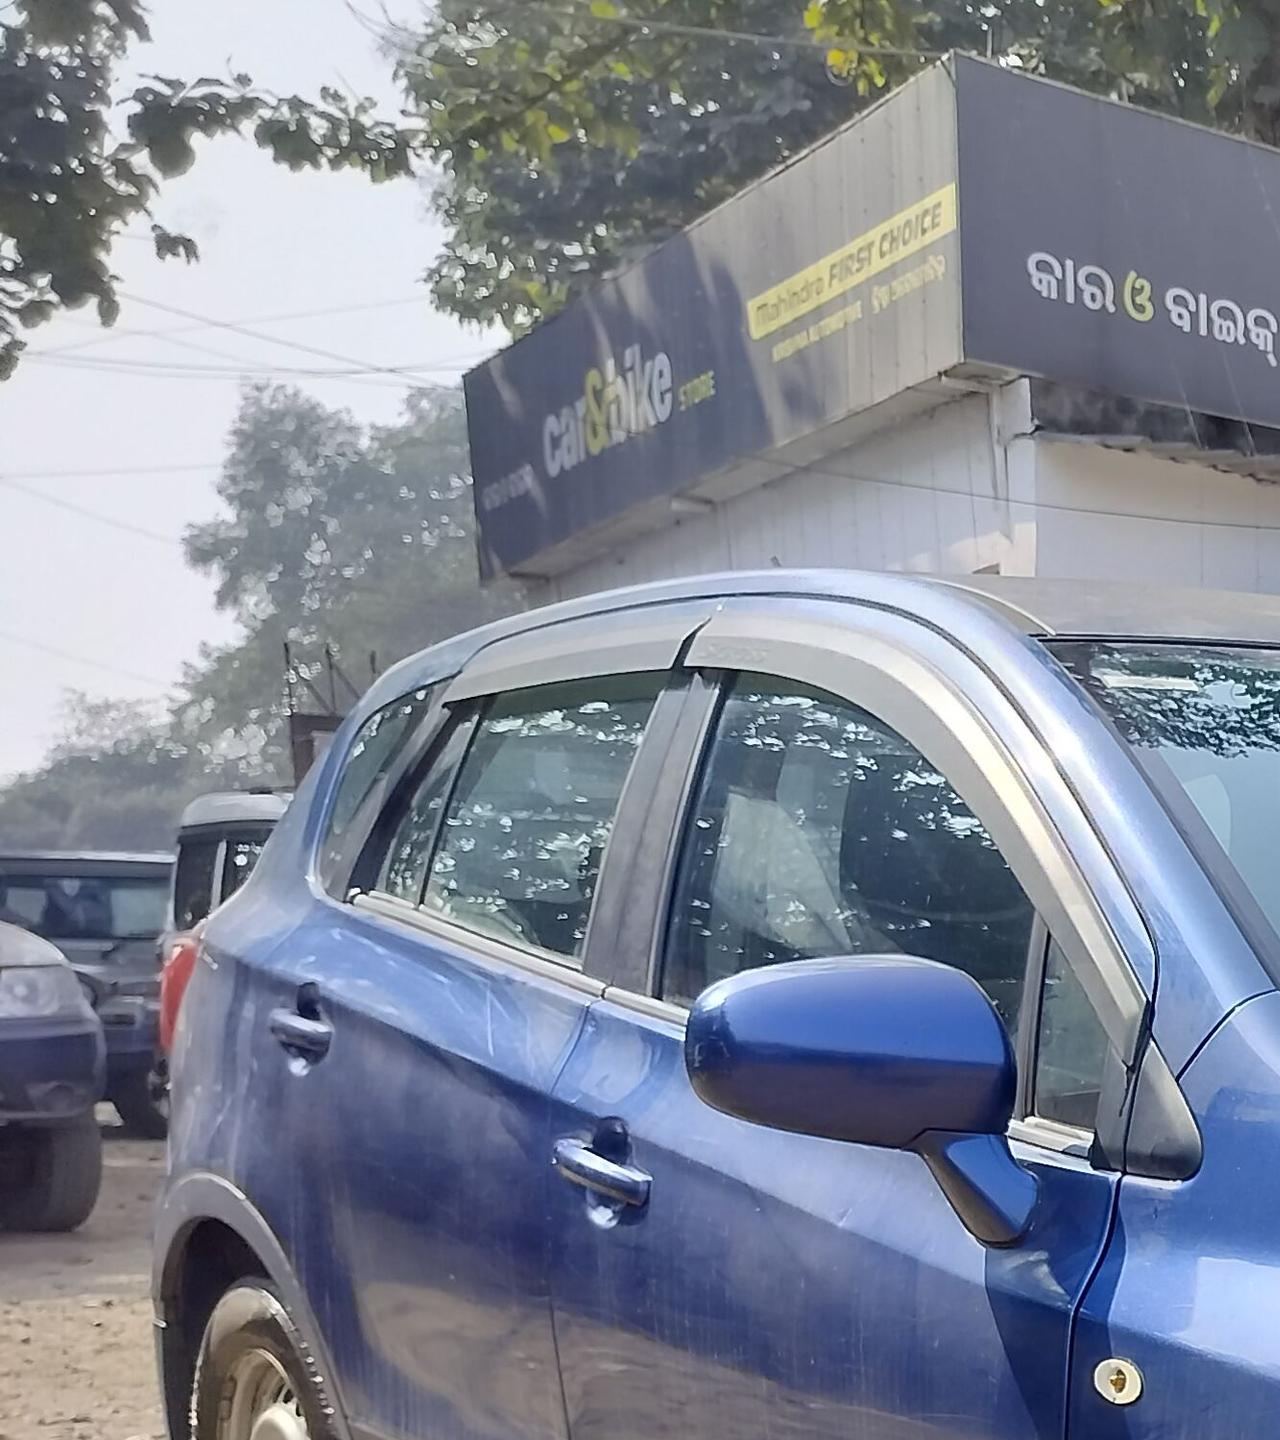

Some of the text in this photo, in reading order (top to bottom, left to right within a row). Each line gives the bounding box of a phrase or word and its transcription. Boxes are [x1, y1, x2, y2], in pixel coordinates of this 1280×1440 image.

[828, 241, 875, 288] FIRST
[879, 201, 943, 259] CHOICE
[1027, 252, 1116, 313] କାର
[1123, 270, 1155, 322] ଓ
[542, 343, 673, 478] car&bike
